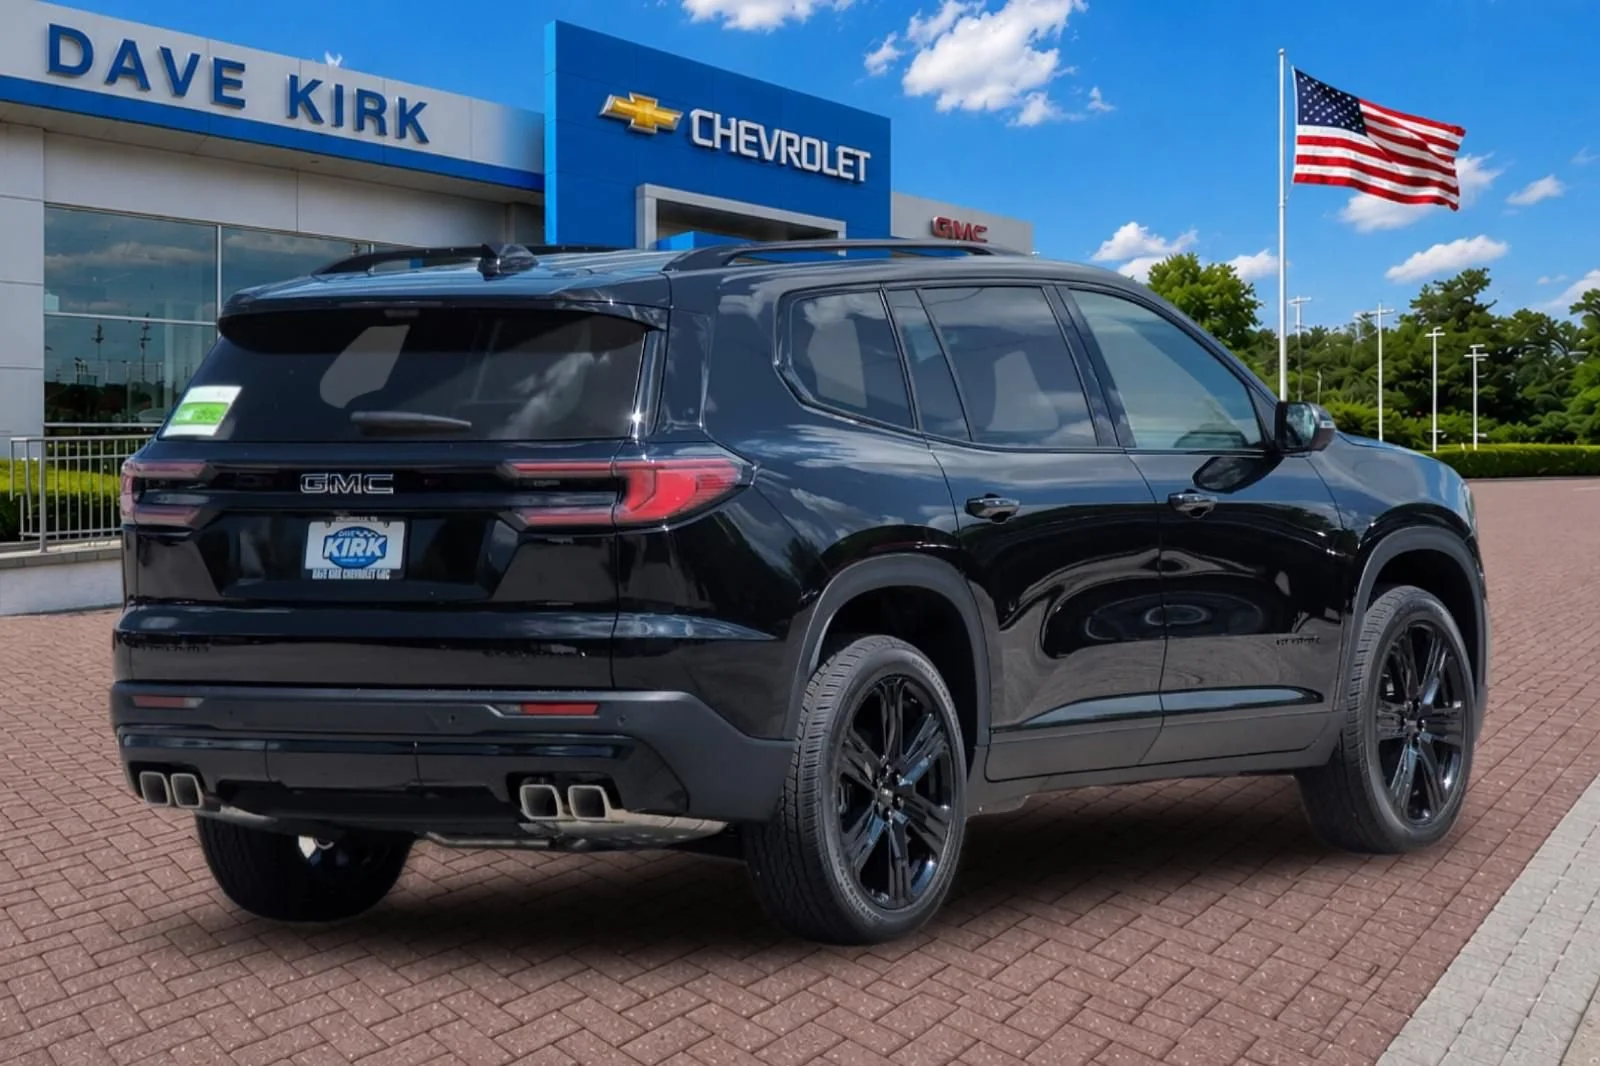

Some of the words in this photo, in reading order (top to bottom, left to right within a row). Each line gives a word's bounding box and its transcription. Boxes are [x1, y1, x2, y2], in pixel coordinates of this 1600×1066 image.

[47, 23, 246, 109] DAVE
[286, 73, 429, 144] KIRK
[690, 108, 871, 183] CHEVROLET
[932, 216, 988, 243] GMC
[300, 473, 393, 494] GMC
[323, 537, 387, 558] KIRK
